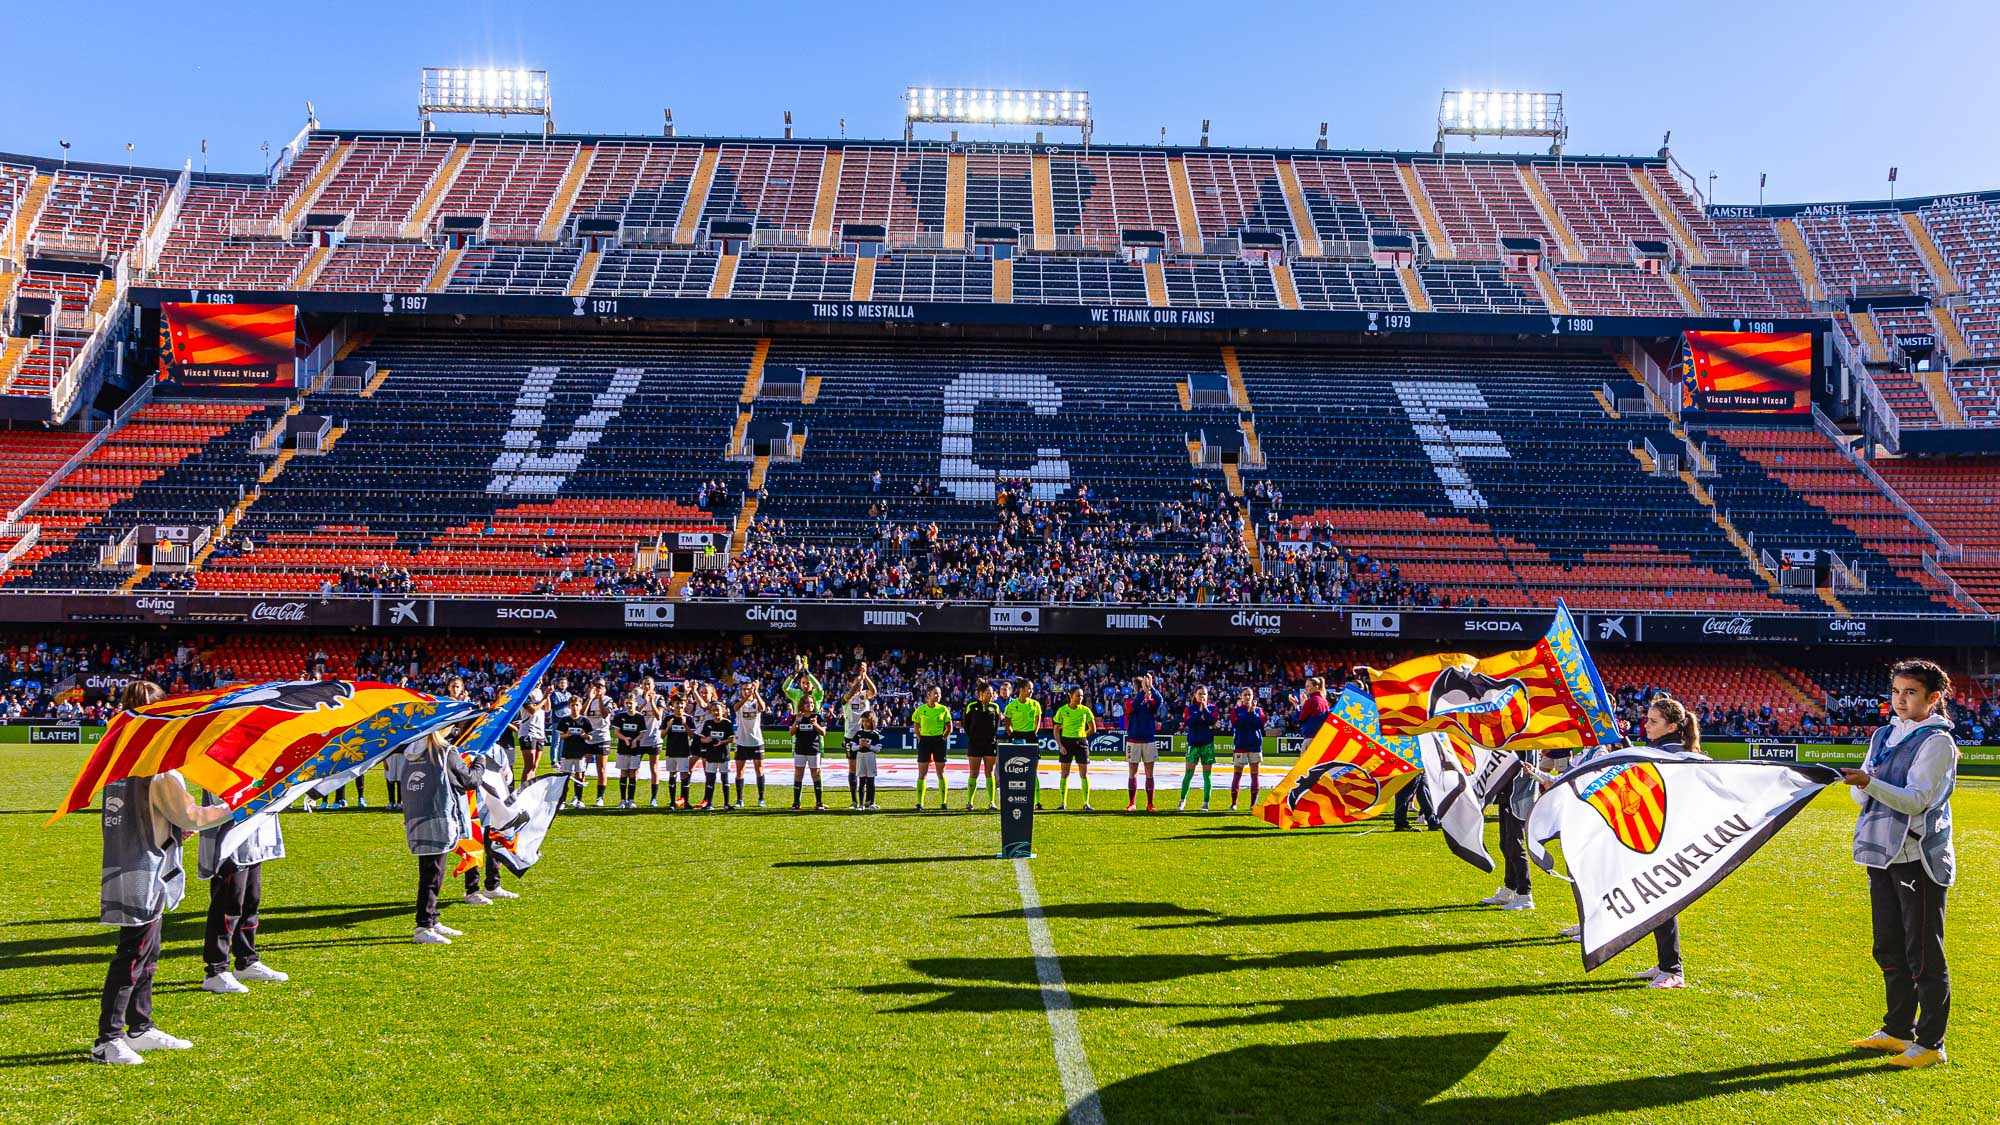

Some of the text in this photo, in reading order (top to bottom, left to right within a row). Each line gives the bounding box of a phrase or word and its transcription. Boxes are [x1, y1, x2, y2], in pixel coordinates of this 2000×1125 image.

[1931, 194, 1980, 209] AMSTEL
[1712, 207, 1755, 218] AMSTEL
[1803, 205, 1849, 216] AMSTEL
[206, 293, 234, 305] 1963
[400, 297, 427, 310] 1967
[592, 300, 618, 313] 1971
[812, 304, 914, 318] THIS IS MESTALLA
[1091, 309, 1215, 324] WE THANK OUR FANS!
[1384, 315, 1411, 328] 1979
[1567, 319, 1593, 331] 1980
[1748, 322, 1774, 334] 1980
[1897, 336, 1934, 346] AMSTEL
[681, 535, 693, 543] TM
[136, 597, 175, 609] divina
[252, 602, 308, 621] Coca-Cola
[496, 608, 558, 619] SKODA
[628, 608, 645, 618] TM
[746, 605, 797, 621] divina
[863, 610, 906, 625] PUMA
[993, 613, 1010, 622] TM
[1106, 614, 1148, 629] PUMA
[1231, 611, 1281, 627] divina
[1355, 617, 1371, 627] TM
[1829, 619, 1866, 631] divina
[770, 621, 797, 630] seguros
[1254, 626, 1280, 635] seguros
[1464, 621, 1523, 631] SKODA
[1703, 617, 1754, 635] Coca-Cola
[86, 675, 129, 688] divina
[32, 731, 77, 741] BLATEM
[1752, 748, 1794, 758] BLATEM
[1821, 751, 1845, 760] pintas
[1971, 752, 1994, 761] pintas
[1009, 766, 1023, 774] Liga
[421, 783, 425, 791] F
